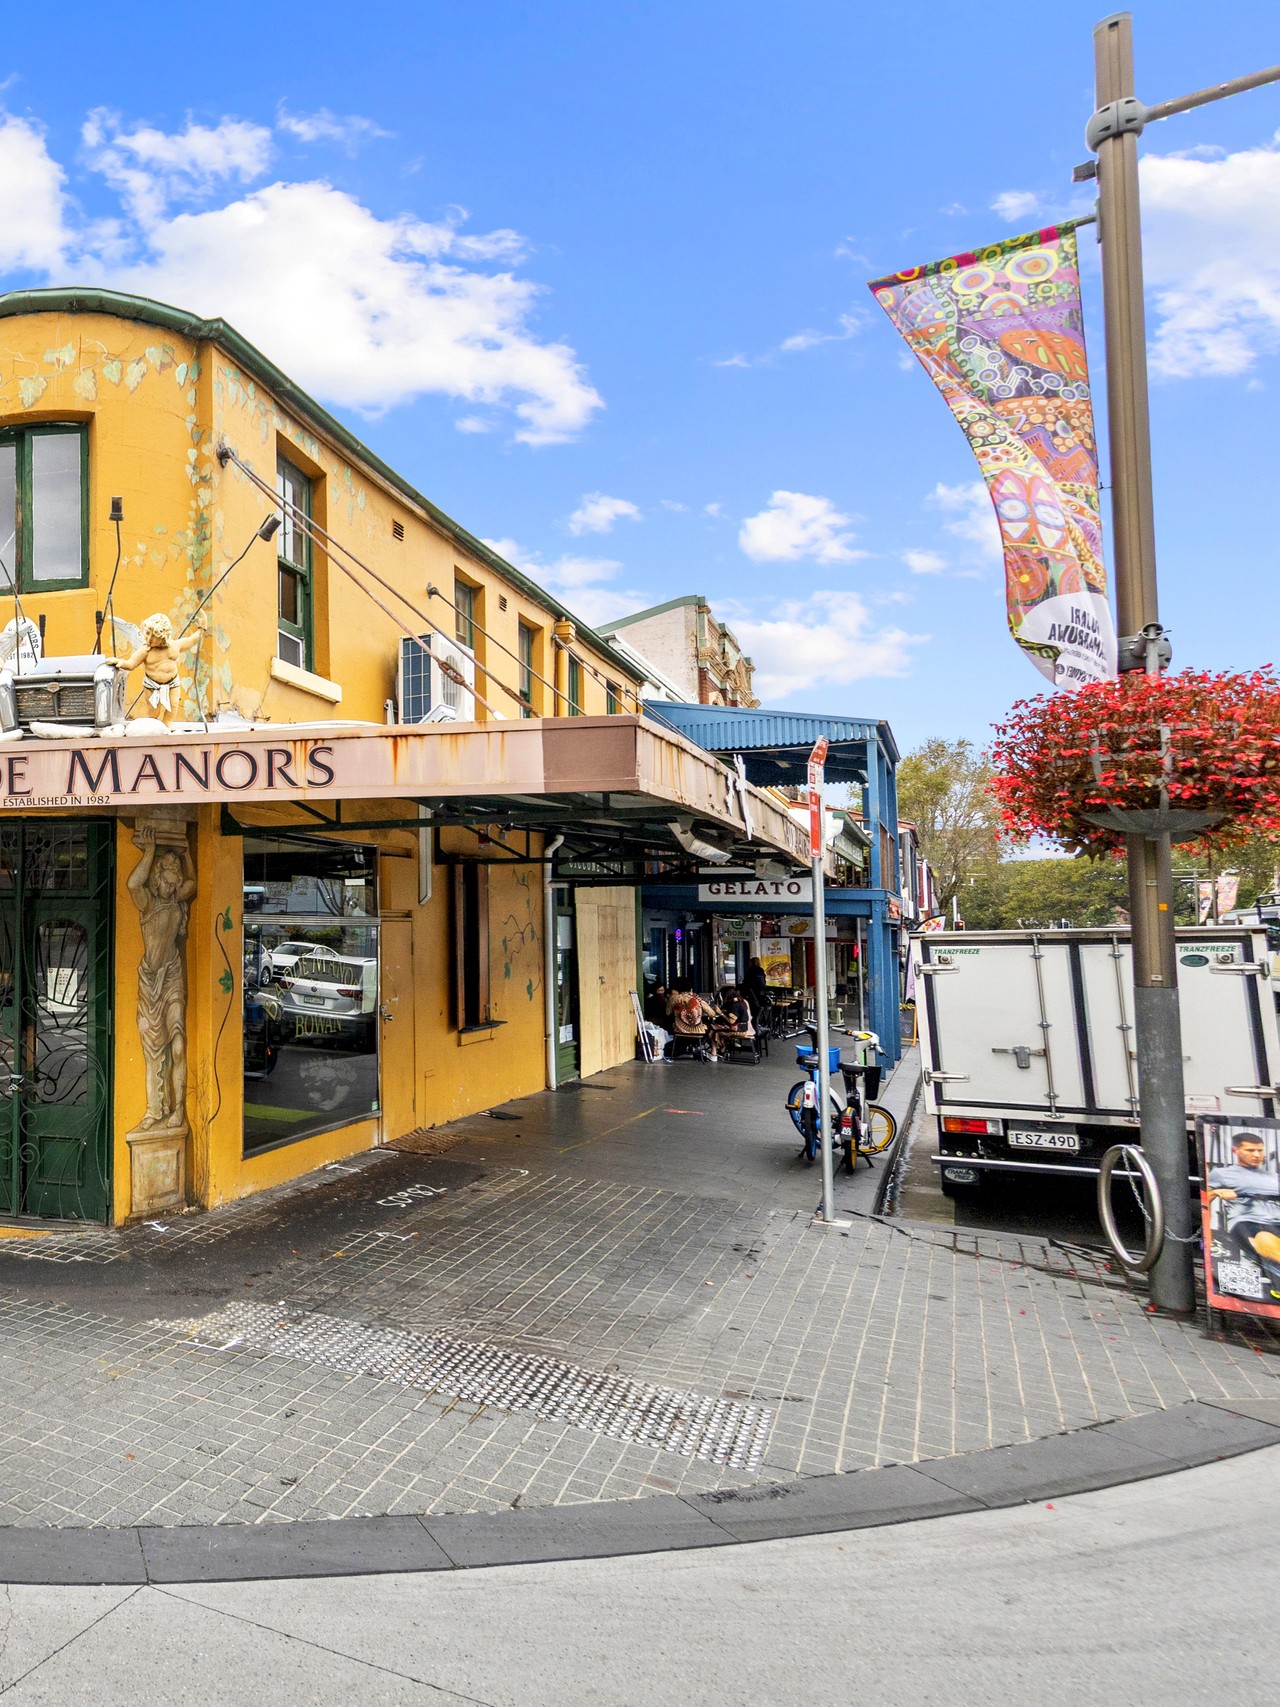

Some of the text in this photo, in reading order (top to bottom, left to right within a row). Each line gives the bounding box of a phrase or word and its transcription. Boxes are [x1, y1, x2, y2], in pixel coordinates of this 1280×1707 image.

[63, 746, 336, 796] MANORS
[3, 795, 110, 807] ESTABLISHED IN 1982
[708, 881, 802, 895] GELATO
[726, 928, 750, 937] home
[1179, 945, 1237, 953] TRANZFREEZE
[294, 1014, 342, 1038] BOWAN
